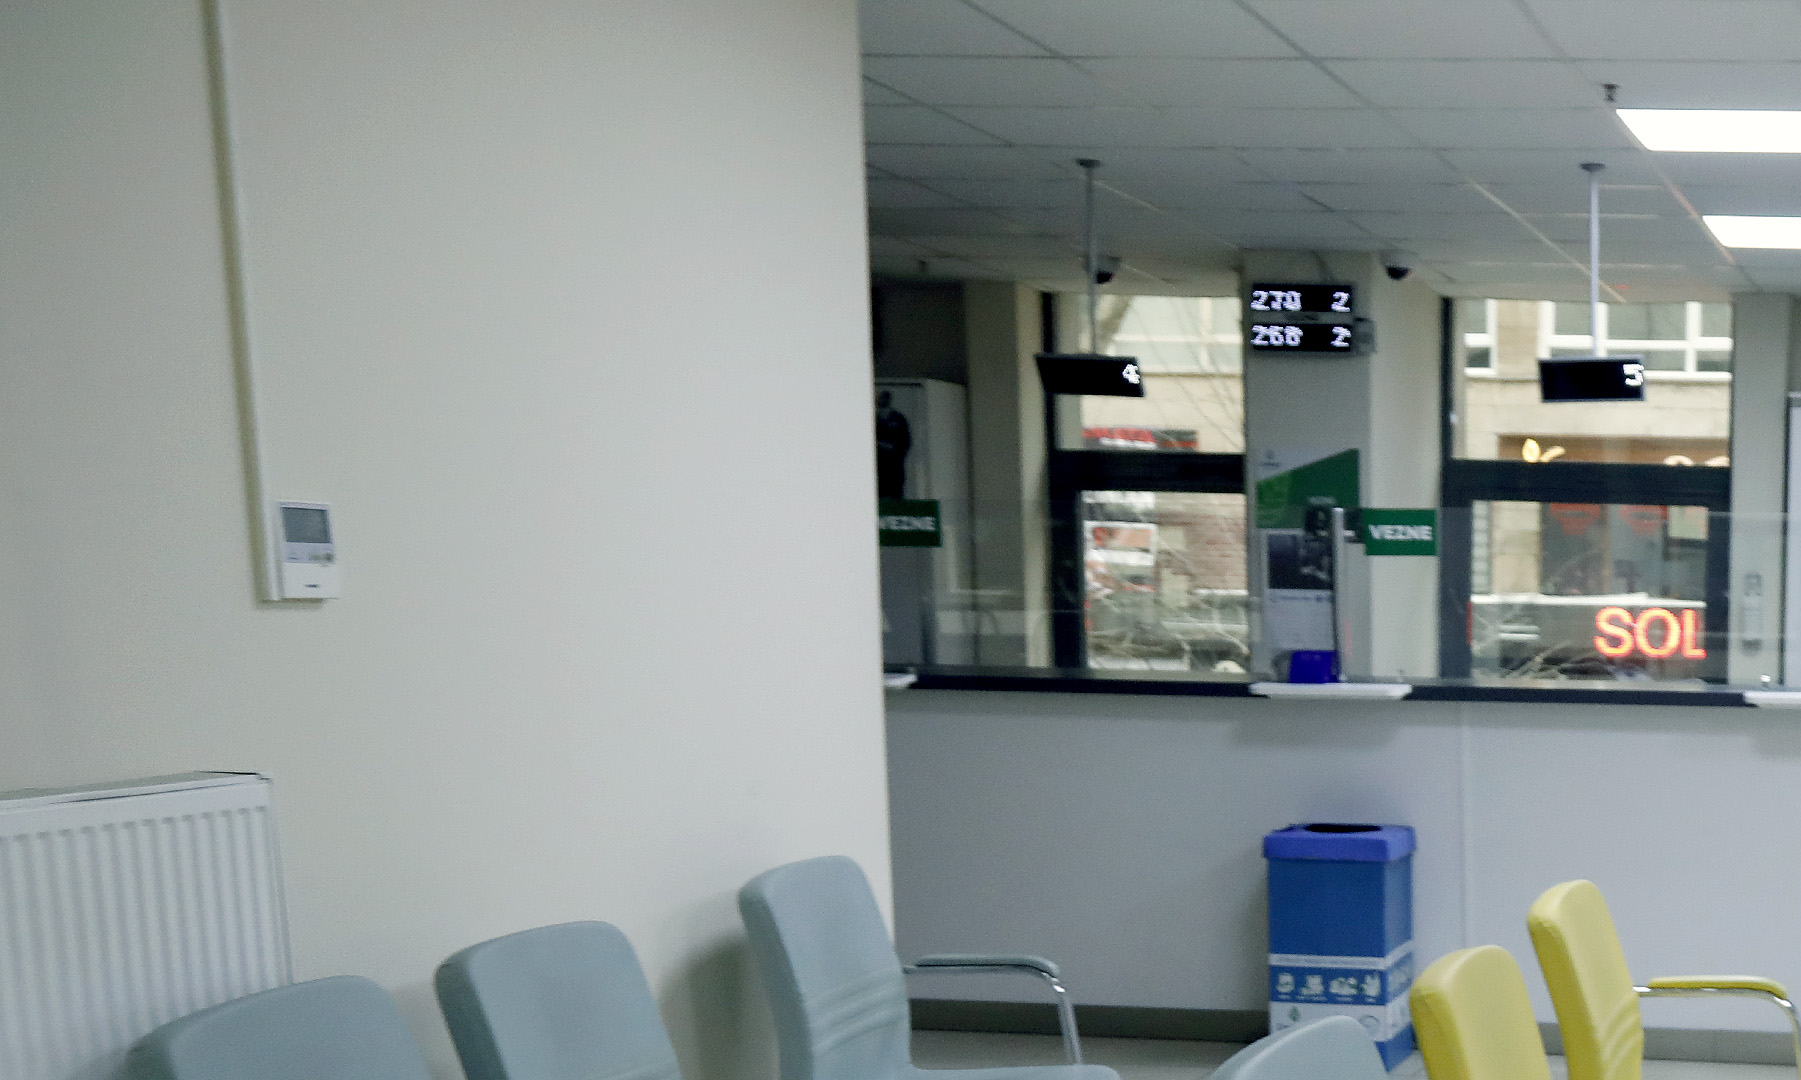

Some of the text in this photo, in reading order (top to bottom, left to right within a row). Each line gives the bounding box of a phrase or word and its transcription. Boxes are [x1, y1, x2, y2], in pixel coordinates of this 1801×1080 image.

[1330, 291, 1351, 313] 2
[1330, 326, 1352, 348] 2
[1122, 363, 1140, 384] 4
[1622, 363, 1645, 386] 5
[1367, 524, 1433, 541] VEZNE
[1593, 605, 1708, 660] SOL
